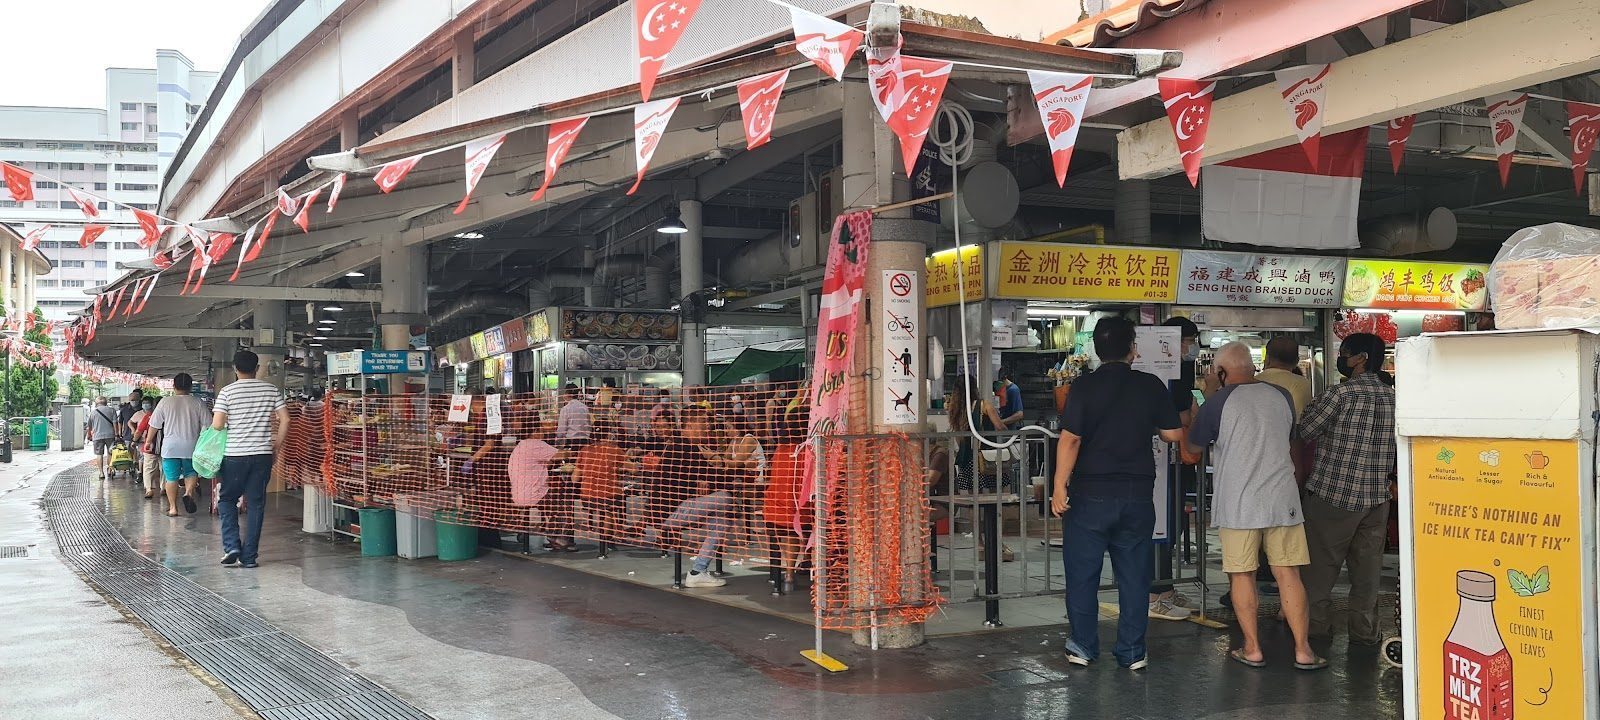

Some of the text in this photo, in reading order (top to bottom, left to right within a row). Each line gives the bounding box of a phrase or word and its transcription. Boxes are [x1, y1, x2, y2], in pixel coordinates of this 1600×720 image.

[1041, 93, 1084, 109] SINGAPORE
[1289, 82, 1324, 105] SINGAPORE
[1491, 107, 1521, 120] SINGAPORE
[922, 147, 938, 160] POLICE
[1008, 249, 1170, 277] 金洲冷热饮品
[943, 285, 951, 293] RE
[968, 279, 981, 288] PIN
[1007, 275, 1169, 288] JIN ZHOU LENG RE YIN PIN
[1379, 268, 1456, 294] 鸿丰鸡饭
[1144, 291, 1168, 299] #01-38
[1187, 283, 1334, 296] SENG HENG BRAISED DUCK
[1428, 474, 1465, 482] Antioxidants
[1483, 477, 1503, 486] Sugar
[1520, 479, 1555, 488] Flavourful
[1526, 472, 1541, 480] Rich
[1429, 502, 1561, 527] "THERE'S NOTHING AN
[1422, 522, 1571, 551] ICE MILK TEA CAN'T FIX"
[1519, 606, 1545, 621] FINEST
[1509, 622, 1553, 641] CEYLON TEA
[1520, 642, 1546, 658] LEAVES
[1448, 652, 1482, 685] TRZ
[1449, 697, 1481, 720] TEA
